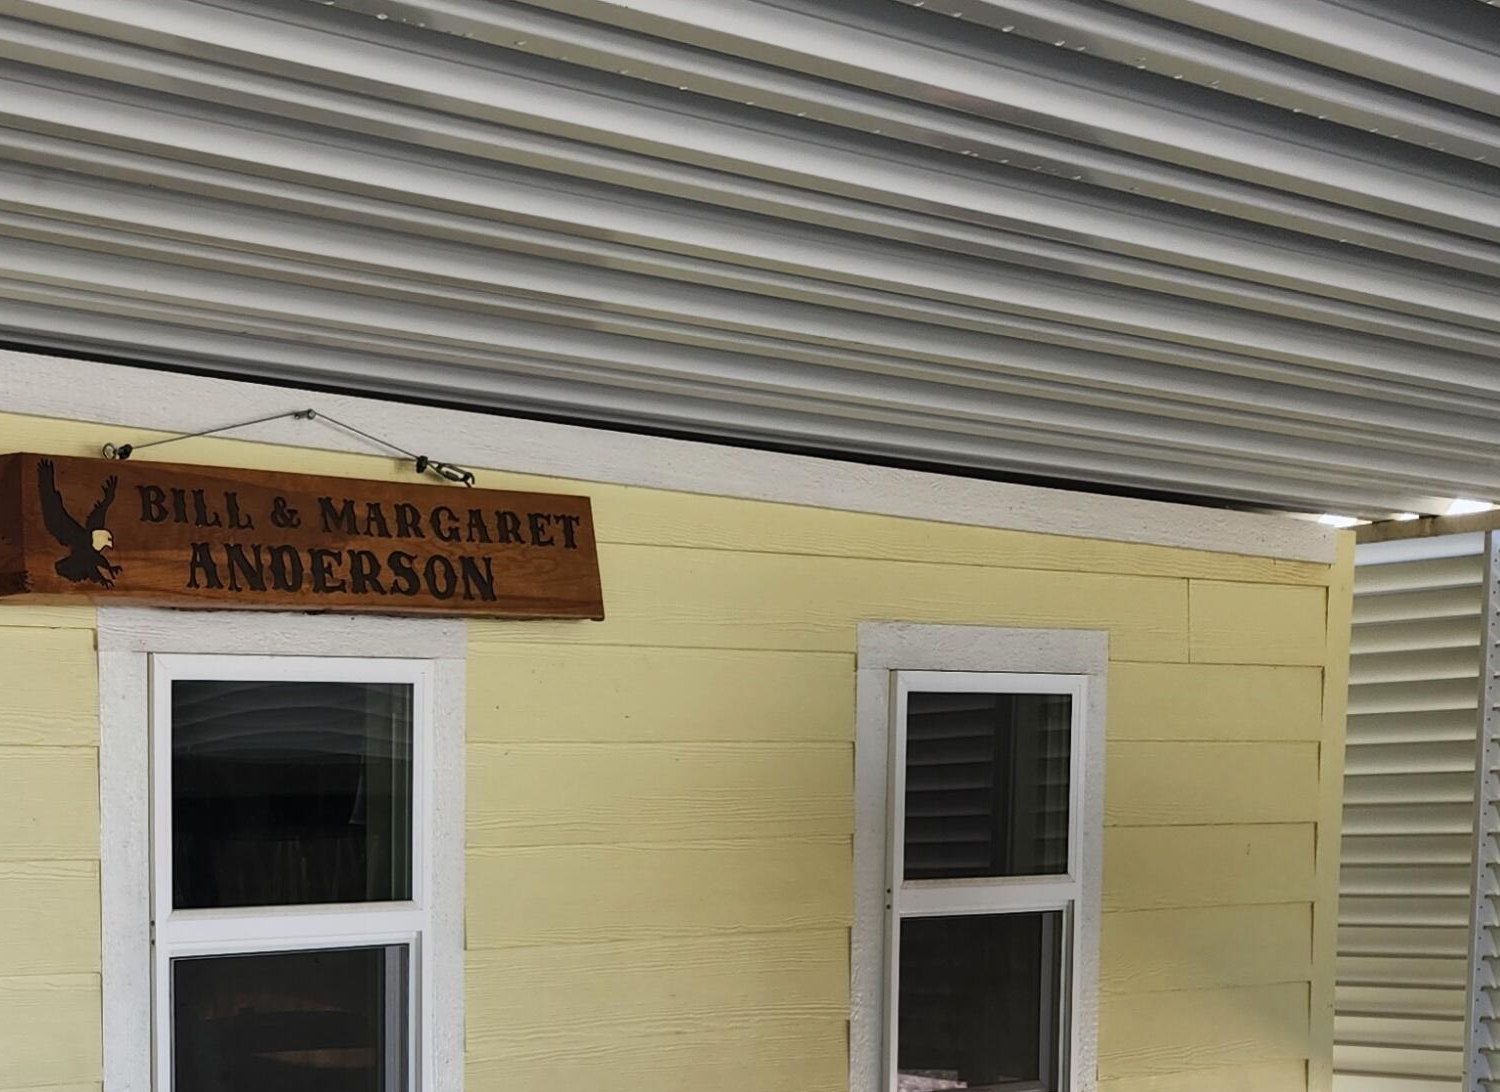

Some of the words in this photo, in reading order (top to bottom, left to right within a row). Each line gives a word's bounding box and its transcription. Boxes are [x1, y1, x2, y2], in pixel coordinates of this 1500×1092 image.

[136, 483, 256, 530] BILL
[270, 496, 301, 528] &
[318, 495, 581, 551] MARGARET
[186, 541, 498, 602] ANDERSON
